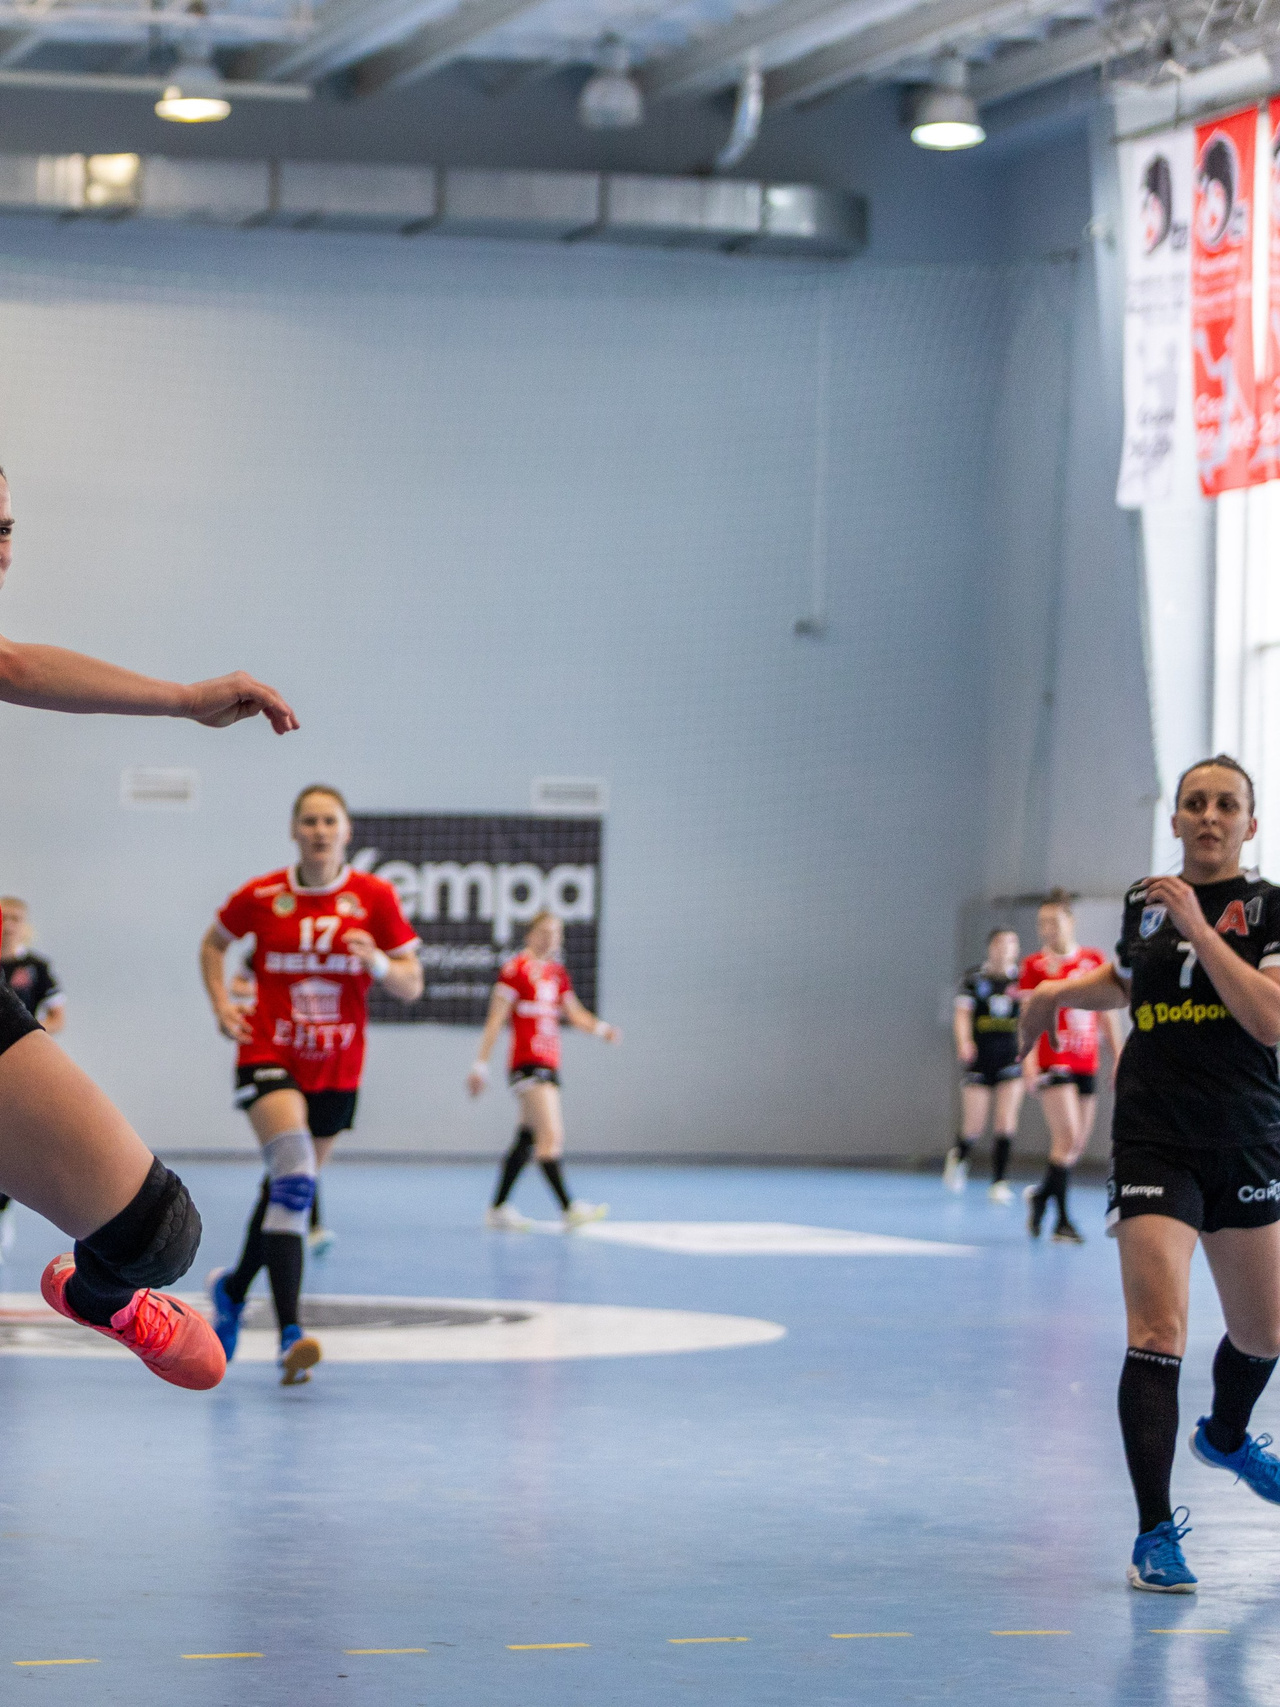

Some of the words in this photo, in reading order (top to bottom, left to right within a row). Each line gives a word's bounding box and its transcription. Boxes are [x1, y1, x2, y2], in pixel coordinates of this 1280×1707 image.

[299, 915, 342, 953] 17
[1216, 896, 1263, 936] A1
[1177, 941, 1197, 989] 7
[1121, 1184, 1165, 1198] Kempa
